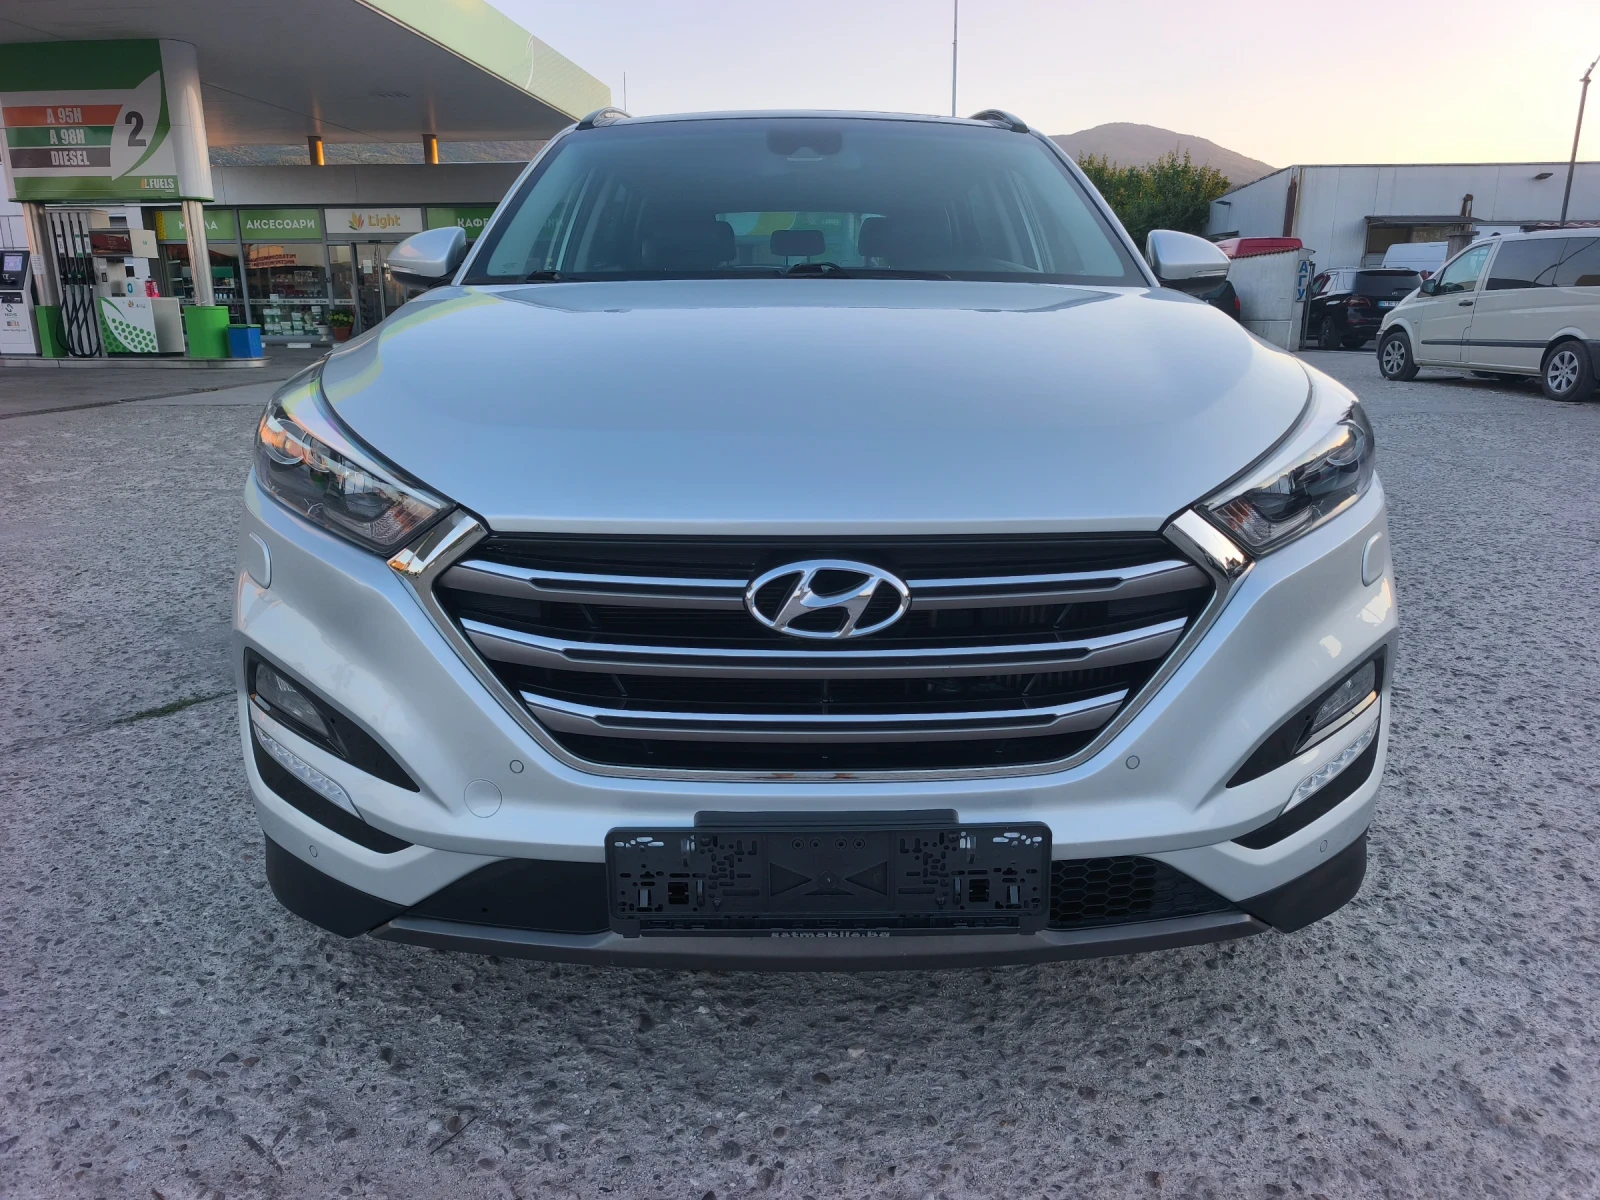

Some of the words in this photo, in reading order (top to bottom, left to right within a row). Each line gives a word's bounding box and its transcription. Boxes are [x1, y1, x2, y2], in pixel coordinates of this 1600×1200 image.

[124, 110, 147, 147] 2
[50, 150, 90, 166] DIESEL
[246, 219, 315, 229] АКСЕСОАРИ
[367, 213, 401, 229] Light
